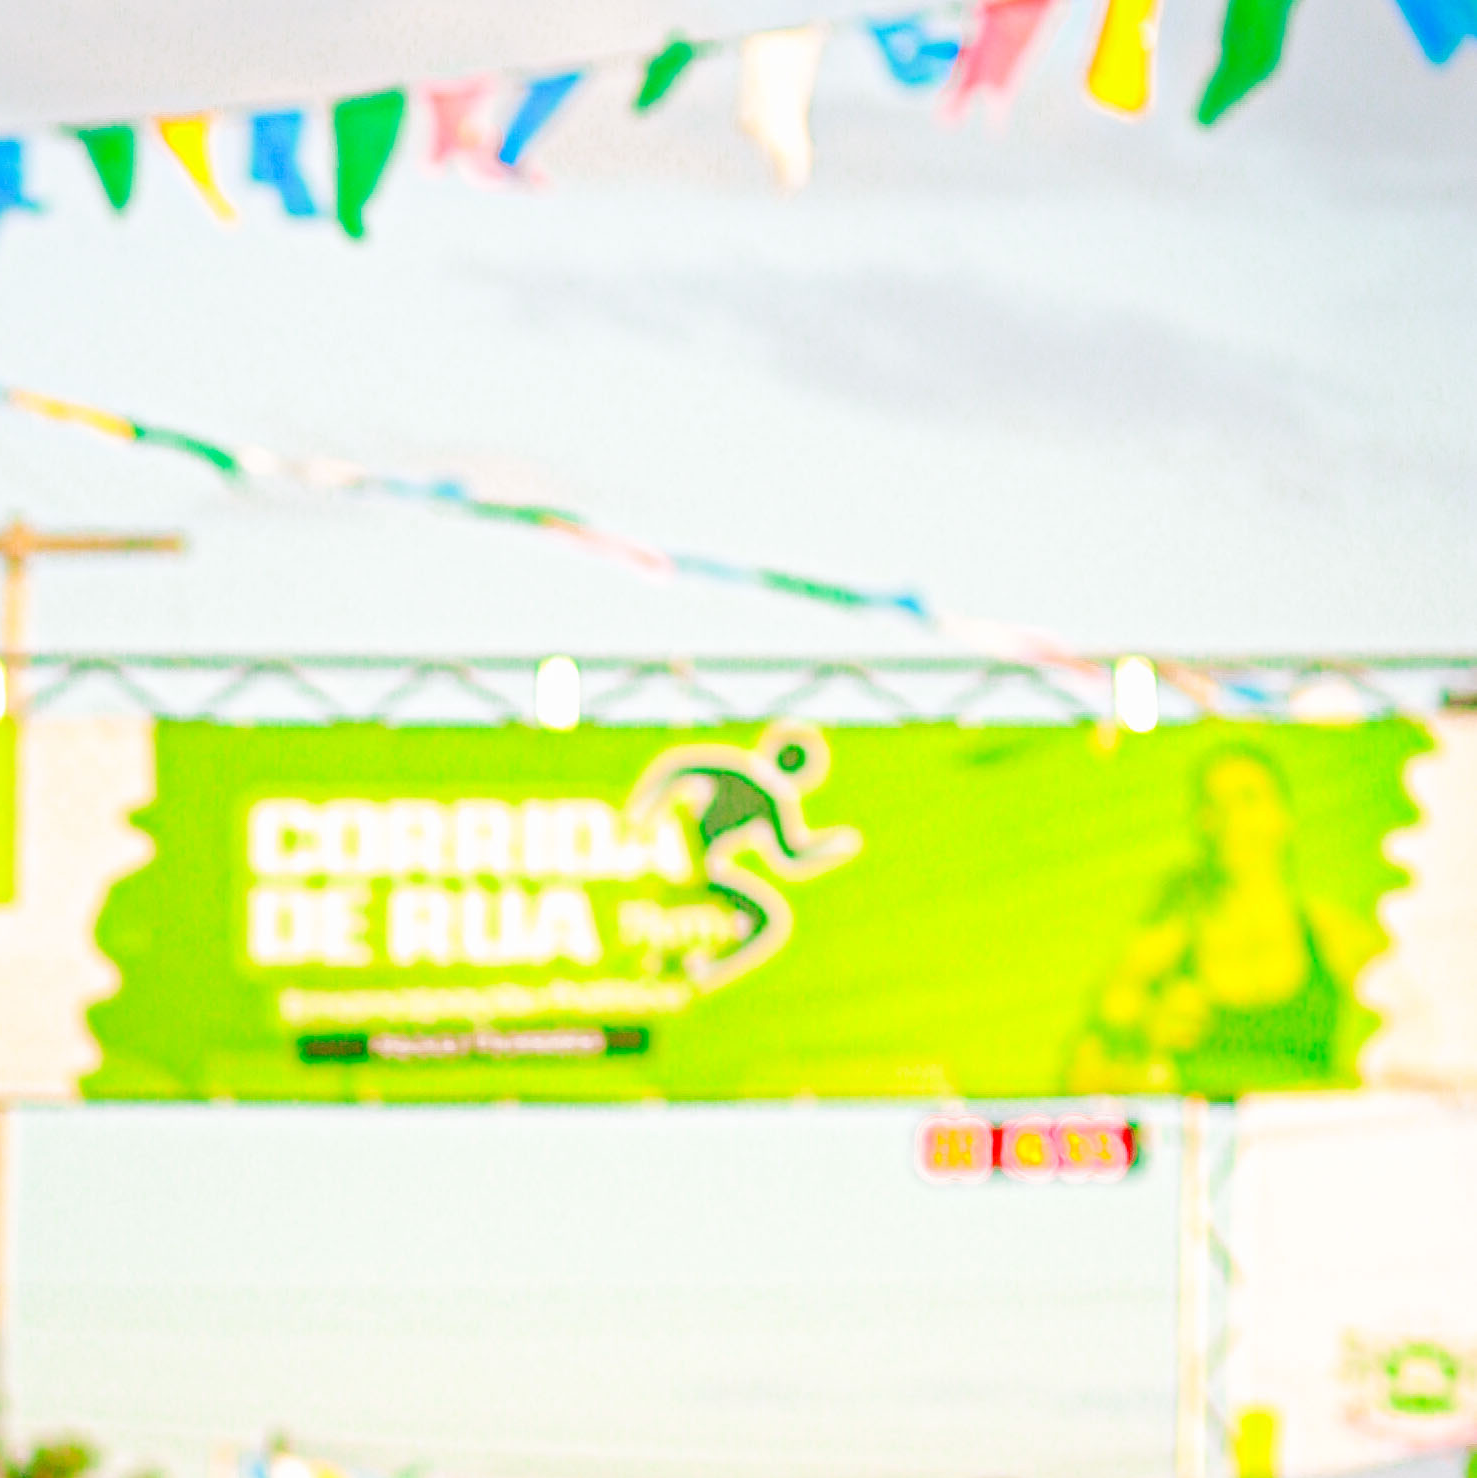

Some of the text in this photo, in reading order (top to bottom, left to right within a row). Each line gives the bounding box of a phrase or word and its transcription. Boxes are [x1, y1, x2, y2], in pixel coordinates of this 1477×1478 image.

[251, 801, 693, 880] CORRIDA
[251, 887, 372, 965] DE
[388, 887, 603, 965] RUA
